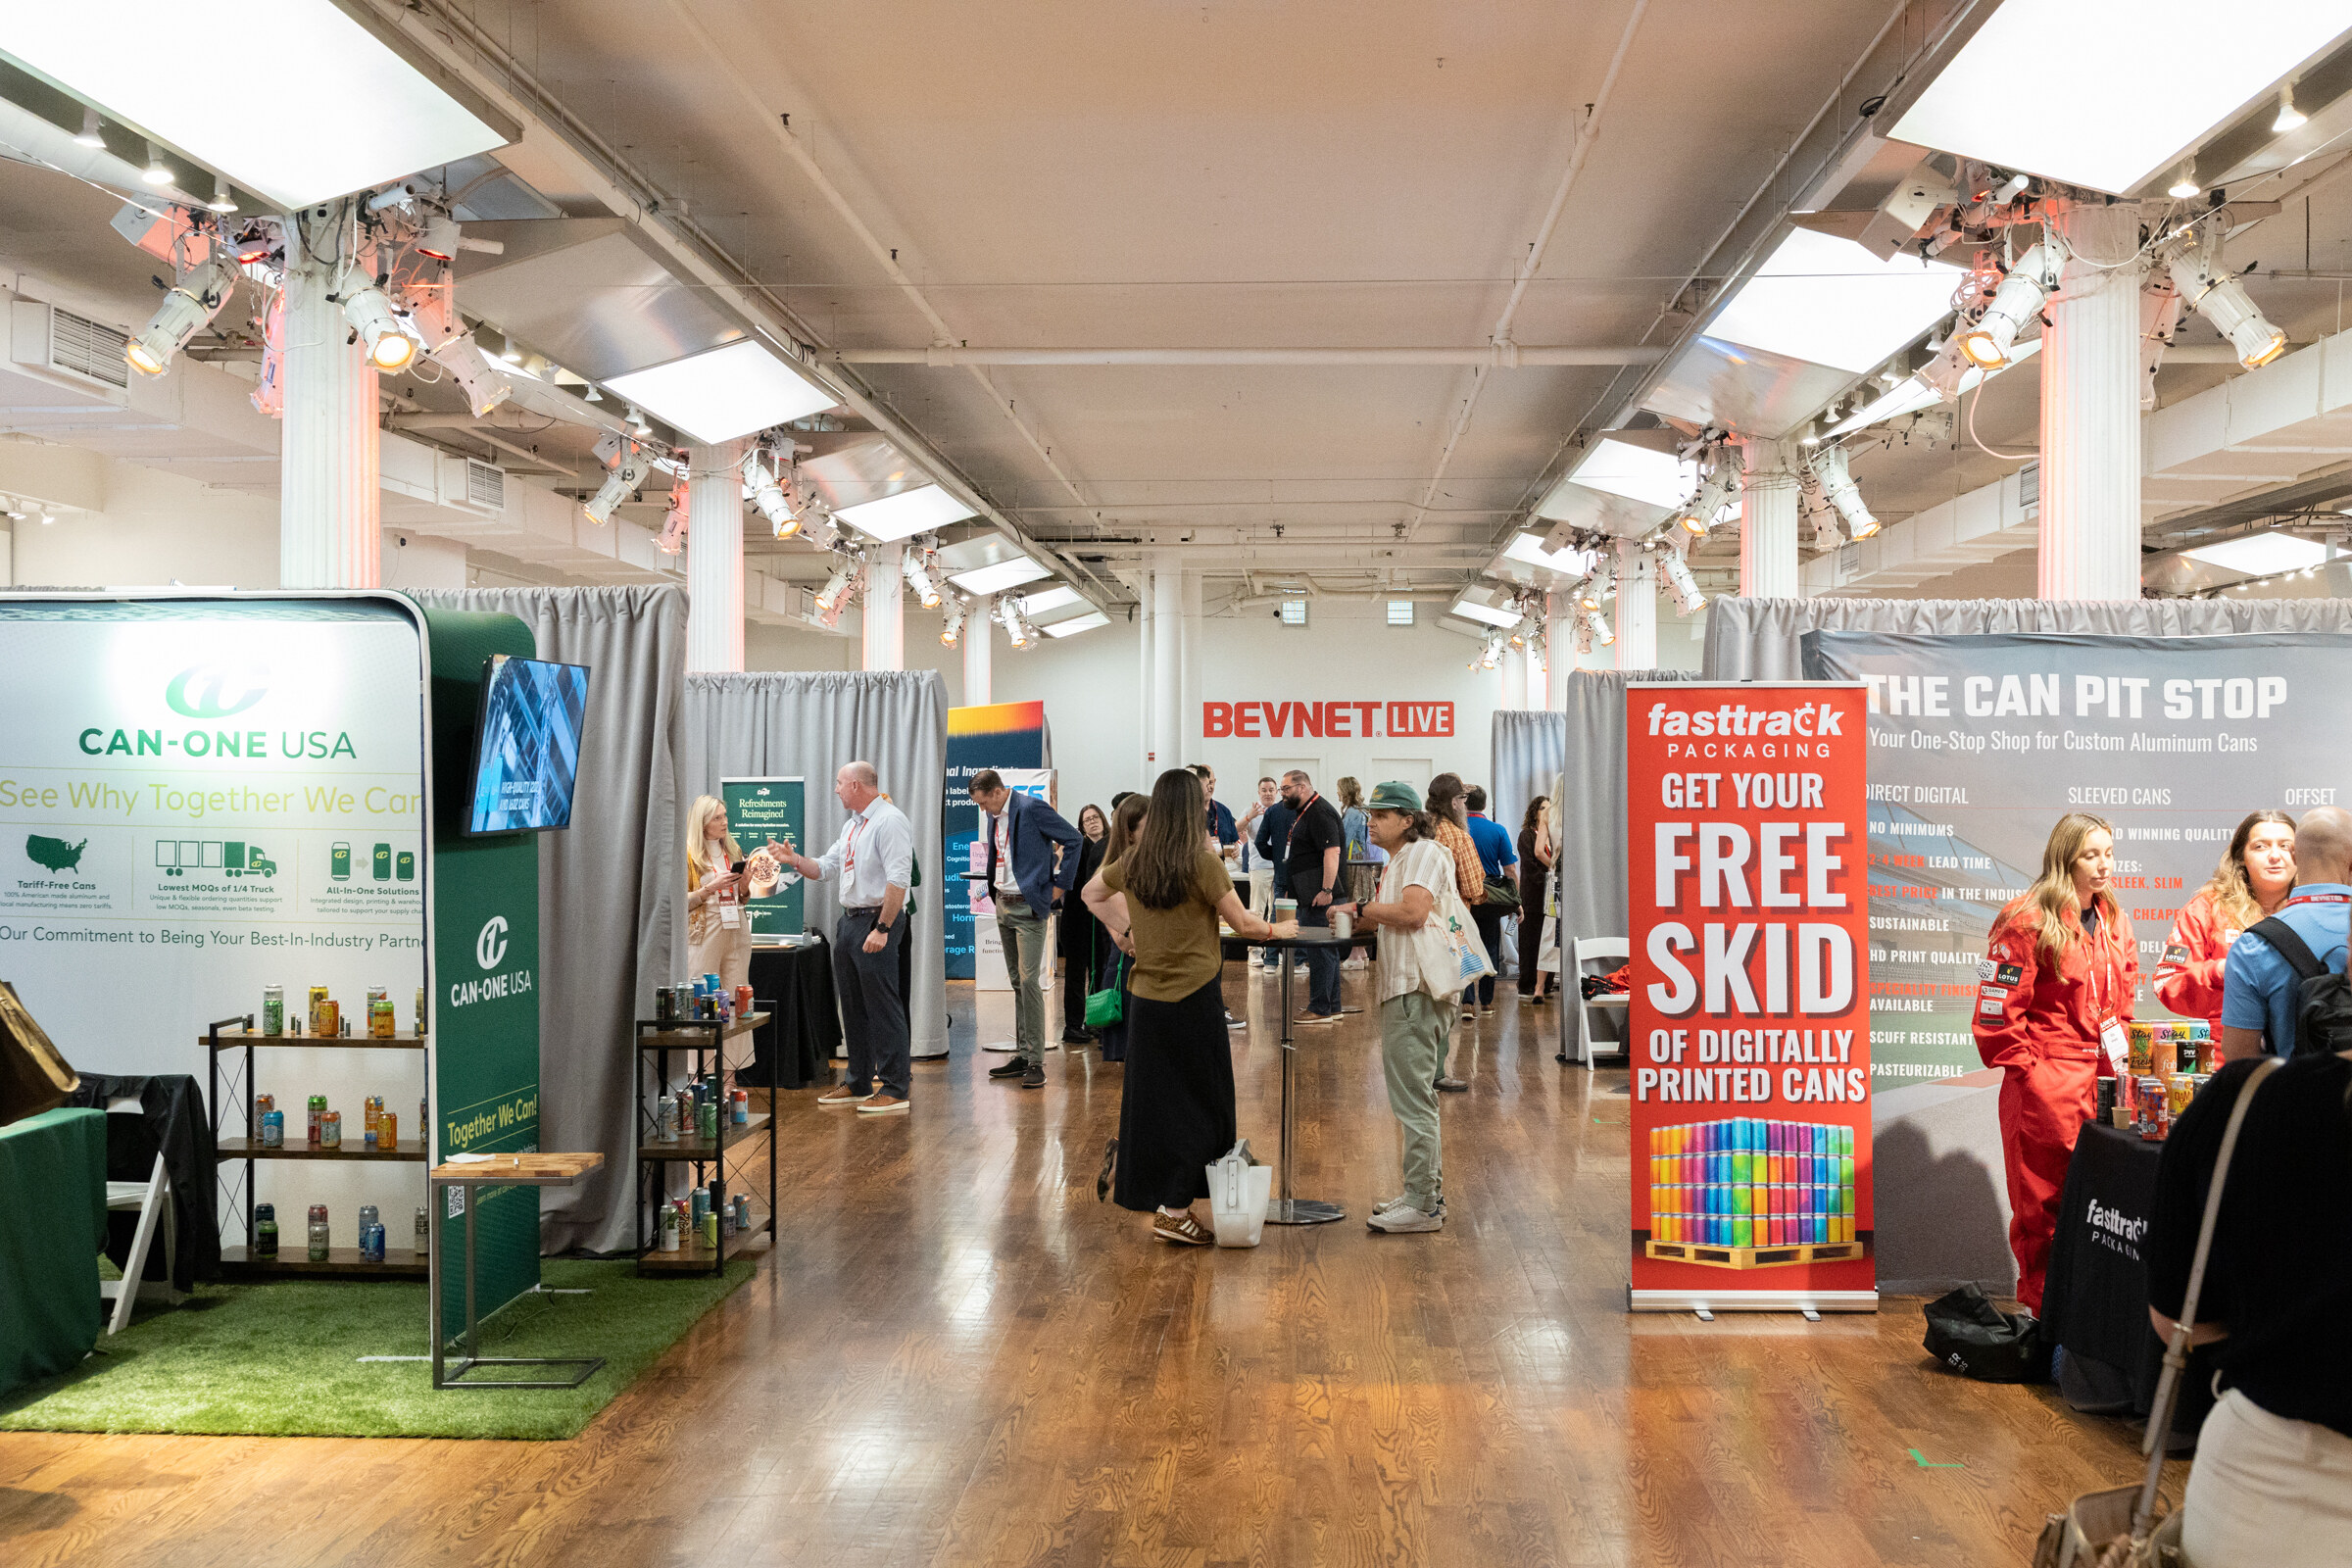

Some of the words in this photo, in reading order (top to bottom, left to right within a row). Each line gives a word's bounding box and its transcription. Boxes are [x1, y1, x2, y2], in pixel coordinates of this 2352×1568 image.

[1859, 674, 1950, 717] THE
[1964, 674, 2060, 717] CAN
[2076, 674, 2149, 718] PIT
[2163, 676, 2287, 719] STOP
[1393, 706, 1449, 733] LIVE
[1647, 702, 1844, 737] fasttrack
[79, 727, 267, 758] CAN-ONE
[282, 731, 357, 760] USA
[1869, 727, 1906, 749] Your
[1911, 730, 1985, 754] One-Stop
[1990, 731, 2031, 754] Shop
[2035, 730, 2059, 750] for
[2064, 730, 2125, 751] Custom
[2130, 732, 2212, 753] Aluminum
[2218, 733, 2258, 753] Cans
[1668, 743, 1831, 759] PACKAGING
[1662, 772, 1722, 808] GET
[1732, 772, 1824, 808] YOUR
[1915, 786, 1969, 805] DIGITAL
[2068, 787, 2128, 805] SLEEVED
[2132, 788, 2172, 806] CANS
[2285, 788, 2336, 806] OFFSET
[0, 780, 59, 808] See
[68, 782, 139, 817] Why
[149, 784, 294, 818] Together
[304, 786, 355, 813] We
[739, 799, 787, 808] Refreshments
[742, 809, 784, 820] Reimagined
[1869, 821, 1886, 834] NO
[1889, 823, 1954, 837] MINIMUMS
[2128, 828, 2180, 841] WINNING
[2185, 828, 2235, 843] QUALITY
[1655, 822, 1846, 907] FREE
[1869, 855, 1889, 867] 2-4
[1893, 856, 1925, 868] WEEK
[1929, 857, 1959, 869] LEAD
[1963, 858, 1991, 869] TIME
[2113, 860, 2142, 873] IZES:
[18, 881, 70, 890] Tariff-Free
[192, 884, 220, 893] MOQs
[377, 887, 419, 896] Solutions
[2110, 876, 2150, 891] SLEEK,
[2154, 877, 2183, 890] SLIM
[150, 894, 171, 903] Unique
[1869, 884, 1897, 897] BEST
[1902, 886, 1938, 899] PRICE
[1941, 887, 1954, 900] IN
[1959, 888, 1982, 901] THE
[16, 901, 57, 909] manufacturing
[350, 907, 373, 916] support
[1869, 916, 1950, 932] SUSTAINABLE
[0, 926, 27, 941] Our
[33, 926, 134, 943] Commitment
[139, 931, 155, 944] to
[161, 930, 205, 949] Being
[211, 930, 245, 945] Your
[251, 931, 373, 951] Best-In-Industry
[1870, 949, 1886, 962] HD
[1890, 950, 1927, 963] PRINT
[1931, 951, 1981, 965] QUALITY
[2166, 954, 2186, 962] LOTUS
[1646, 921, 1853, 1014] SKID
[1997, 973, 2019, 983] LOTUS
[451, 974, 509, 1007] CAN-ONE
[511, 970, 532, 995] USA
[1870, 982, 1937, 997] SPECIALITY
[1870, 999, 1934, 1012] AVAILABLE
[1649, 1029, 1688, 1063] OF
[1698, 1029, 1853, 1063] DIGITALLY
[1870, 1031, 1906, 1044] SCUFF
[1910, 1032, 1975, 1046] RESISTANT
[1870, 1063, 1964, 1078] PASTEURIZABLE
[1638, 1068, 1771, 1102] PRINTED
[1782, 1067, 1866, 1102] CANS
[447, 1112, 497, 1149] Together
[498, 1102, 514, 1129] We
[515, 1093, 537, 1122] Can!
